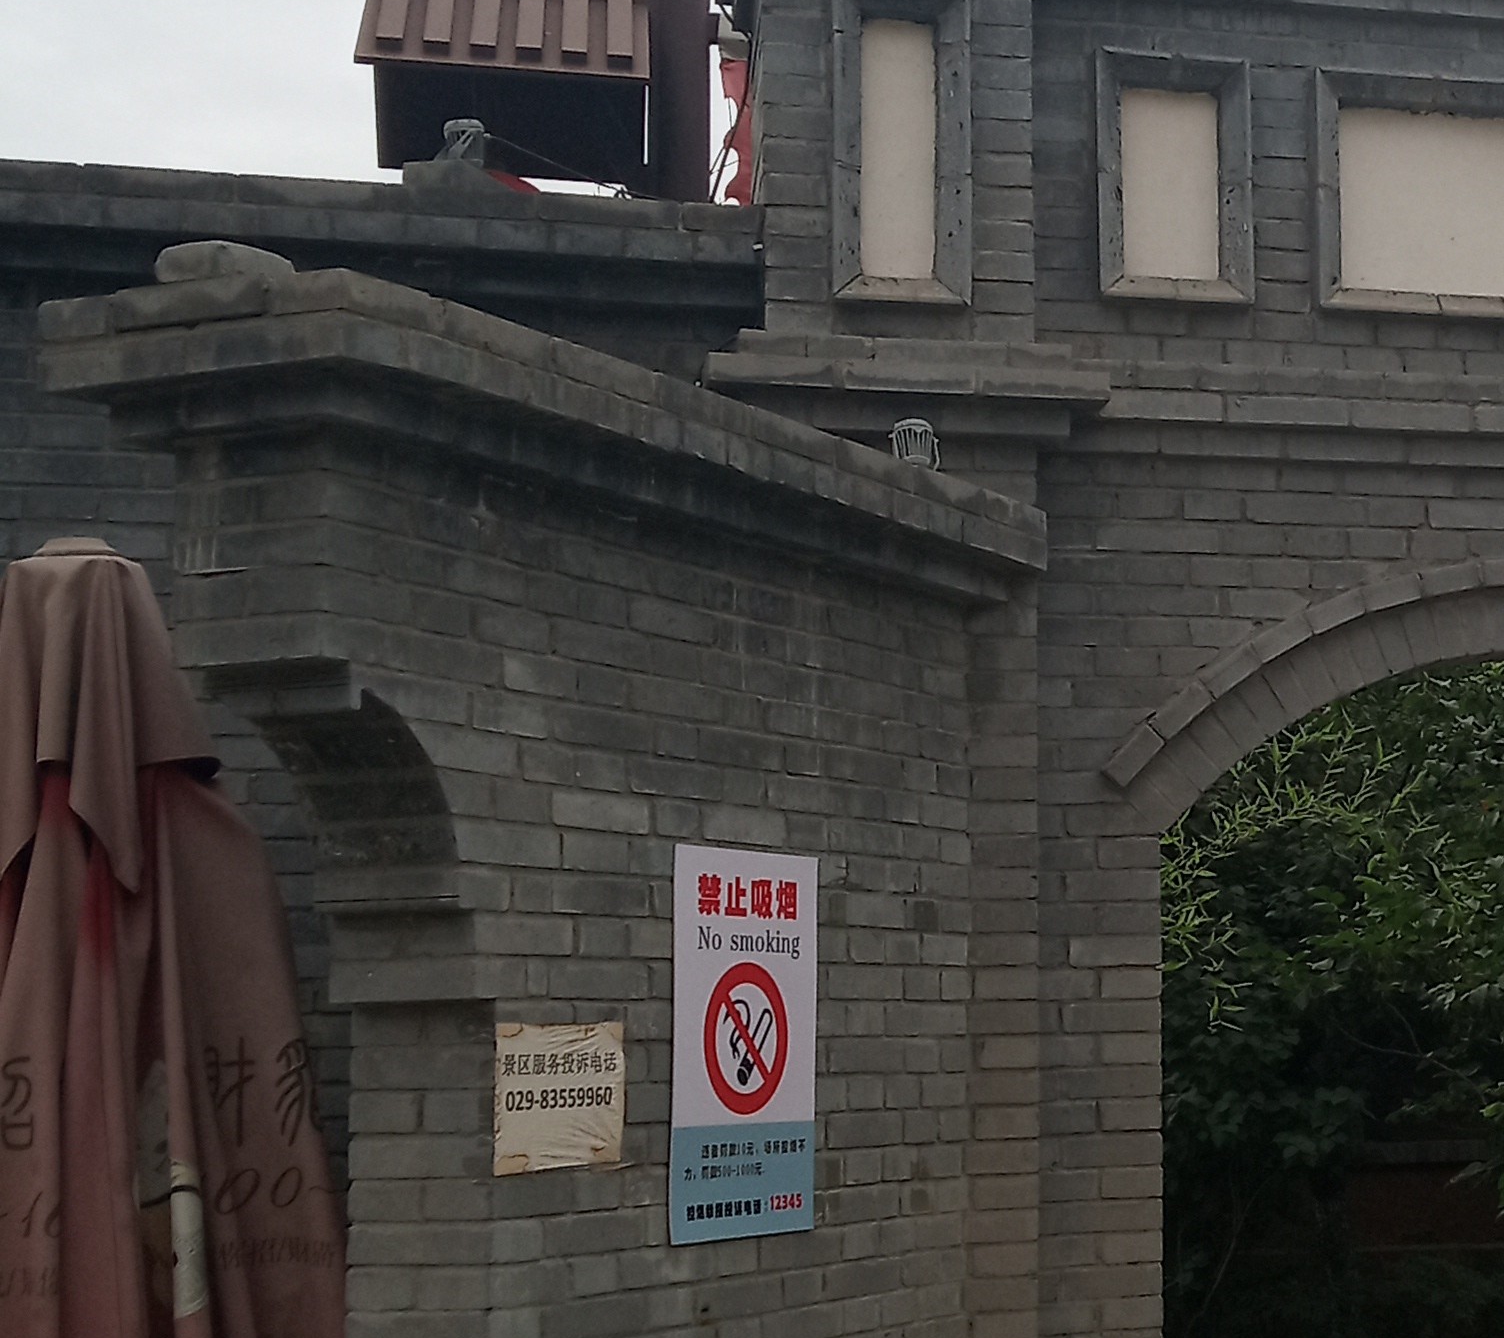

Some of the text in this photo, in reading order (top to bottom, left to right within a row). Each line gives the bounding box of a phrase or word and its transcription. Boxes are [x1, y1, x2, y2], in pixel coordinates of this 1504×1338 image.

[698, 873, 797, 920] 禁止吸烟
[698, 926, 800, 960] No smoking
[502, 1052, 617, 1076] 景区服务投诉电话
[505, 1086, 612, 1112] 029-83559960
